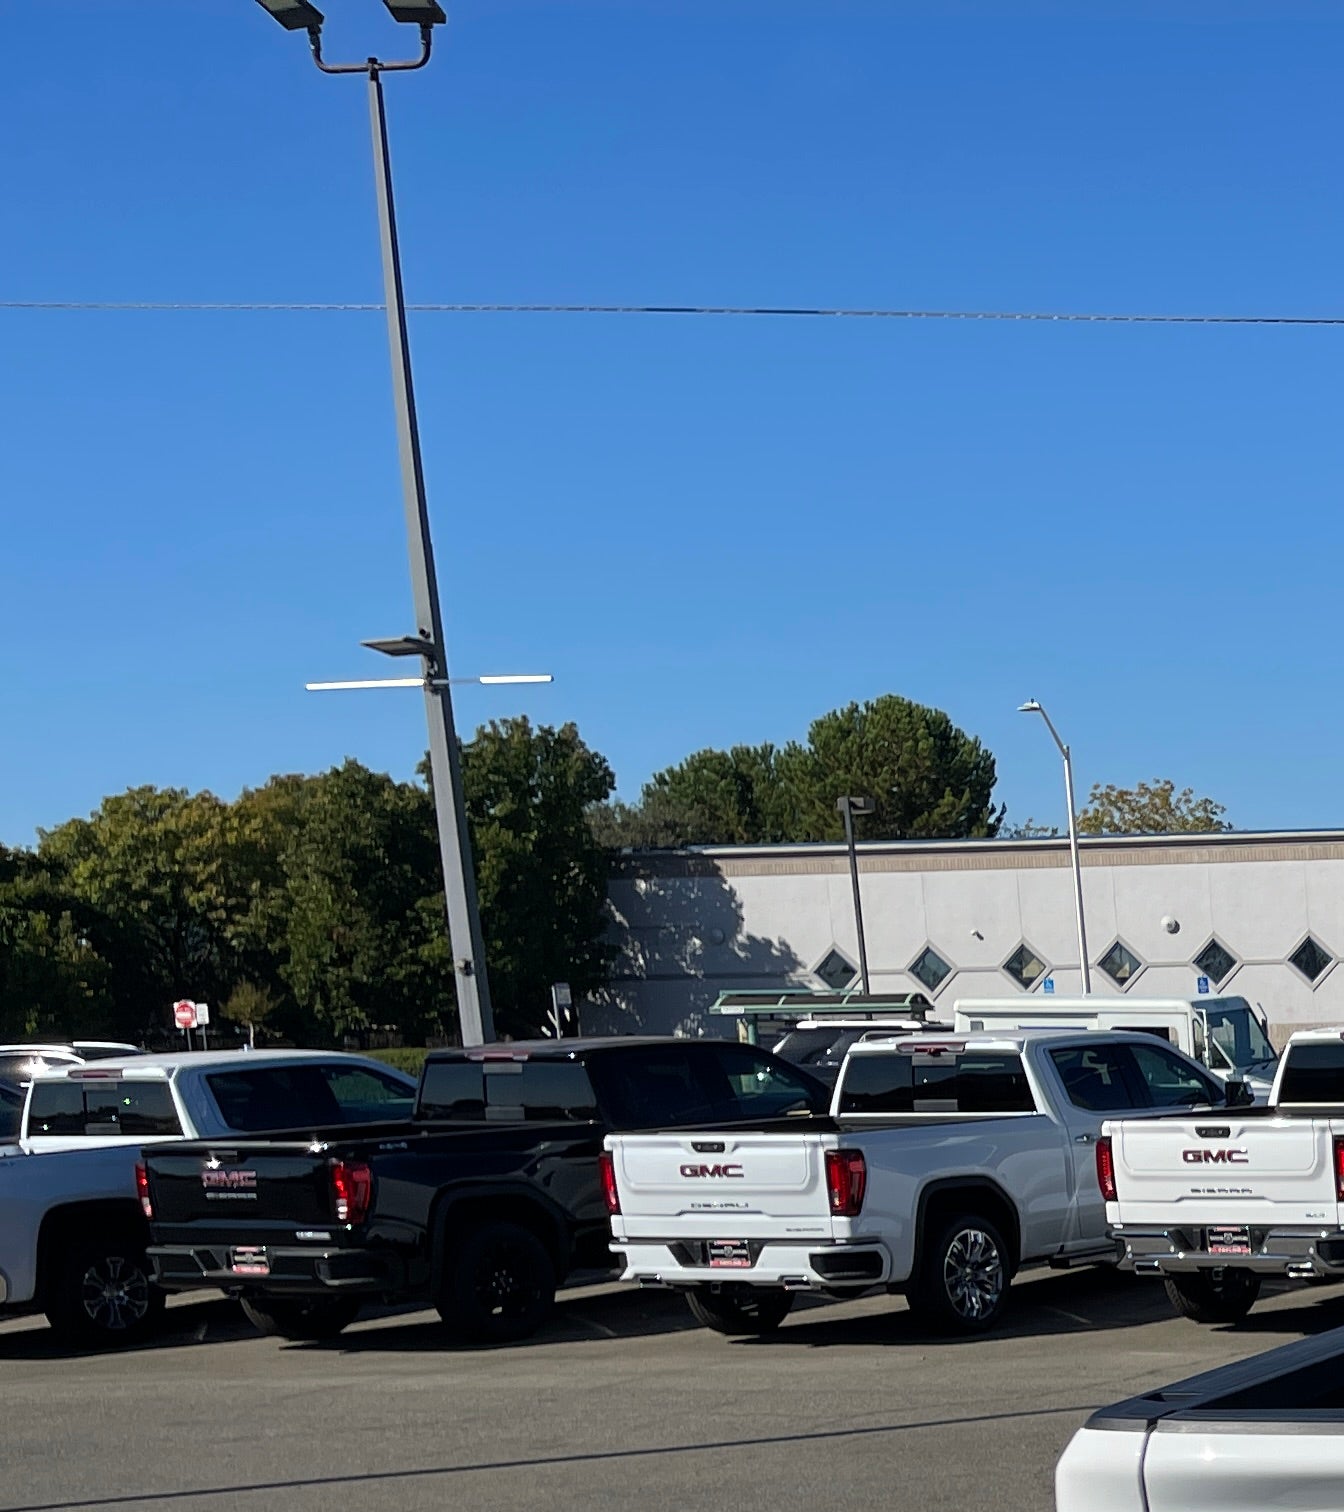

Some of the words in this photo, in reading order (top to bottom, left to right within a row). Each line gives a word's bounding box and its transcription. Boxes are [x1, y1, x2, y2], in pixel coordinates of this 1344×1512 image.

[1182, 1149, 1250, 1164] GMC
[680, 1164, 745, 1178] GMC
[202, 1170, 258, 1188] GMC
